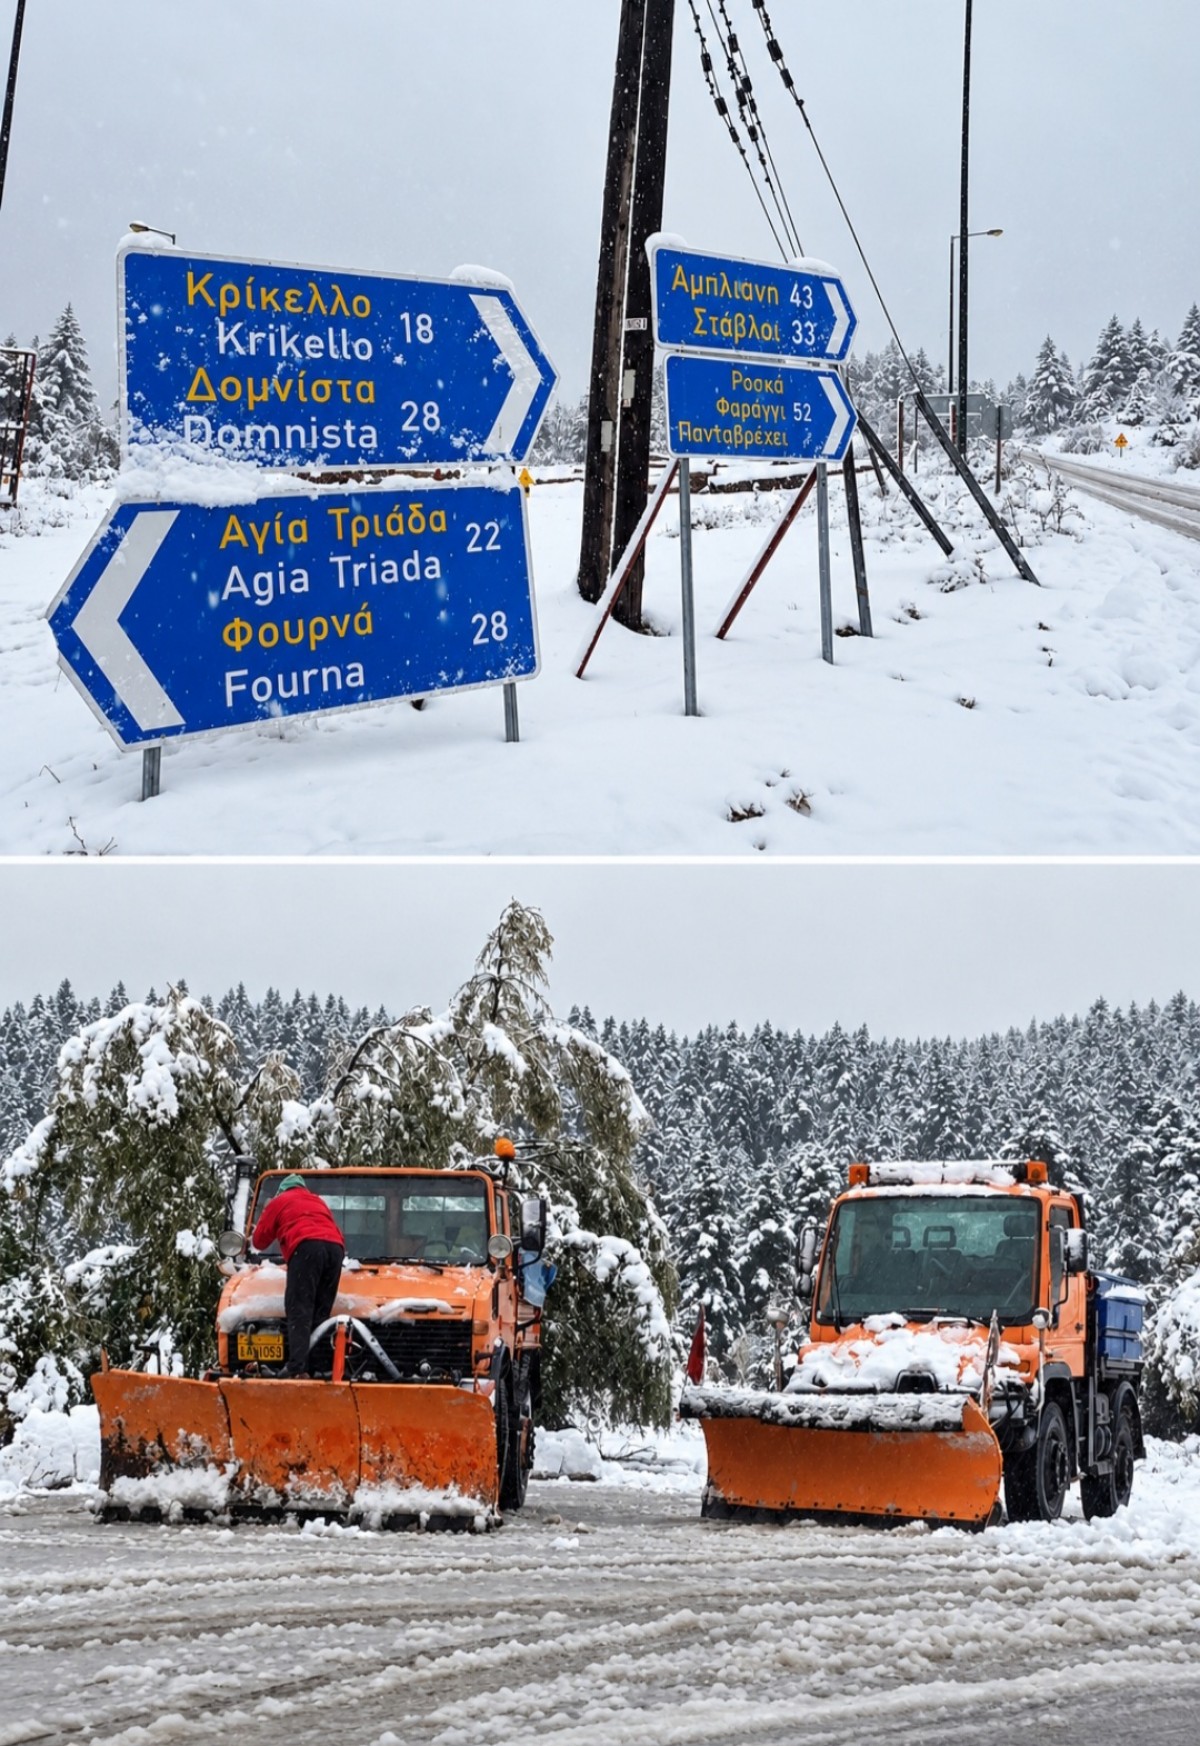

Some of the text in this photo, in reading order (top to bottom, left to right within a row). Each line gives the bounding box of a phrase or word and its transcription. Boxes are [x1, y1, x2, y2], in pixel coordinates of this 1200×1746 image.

[187, 271, 371, 318] Κρίκελλο
[789, 283, 813, 309] 43
[217, 312, 434, 361] Krikello 18
[693, 307, 815, 346] Στάβλοι 33
[186, 367, 376, 411] Δομνίστα
[716, 396, 812, 423] Φαράγγι 52
[183, 400, 441, 450] Domnista 28
[678, 420, 789, 450] Πανταβρέχει
[219, 503, 501, 555] Αγία Τριάδα 22
[221, 549, 442, 606] Agia Triada
[221, 602, 373, 652] Φουρνά
[470, 610, 509, 646] 28
[224, 661, 365, 708] Fourna
